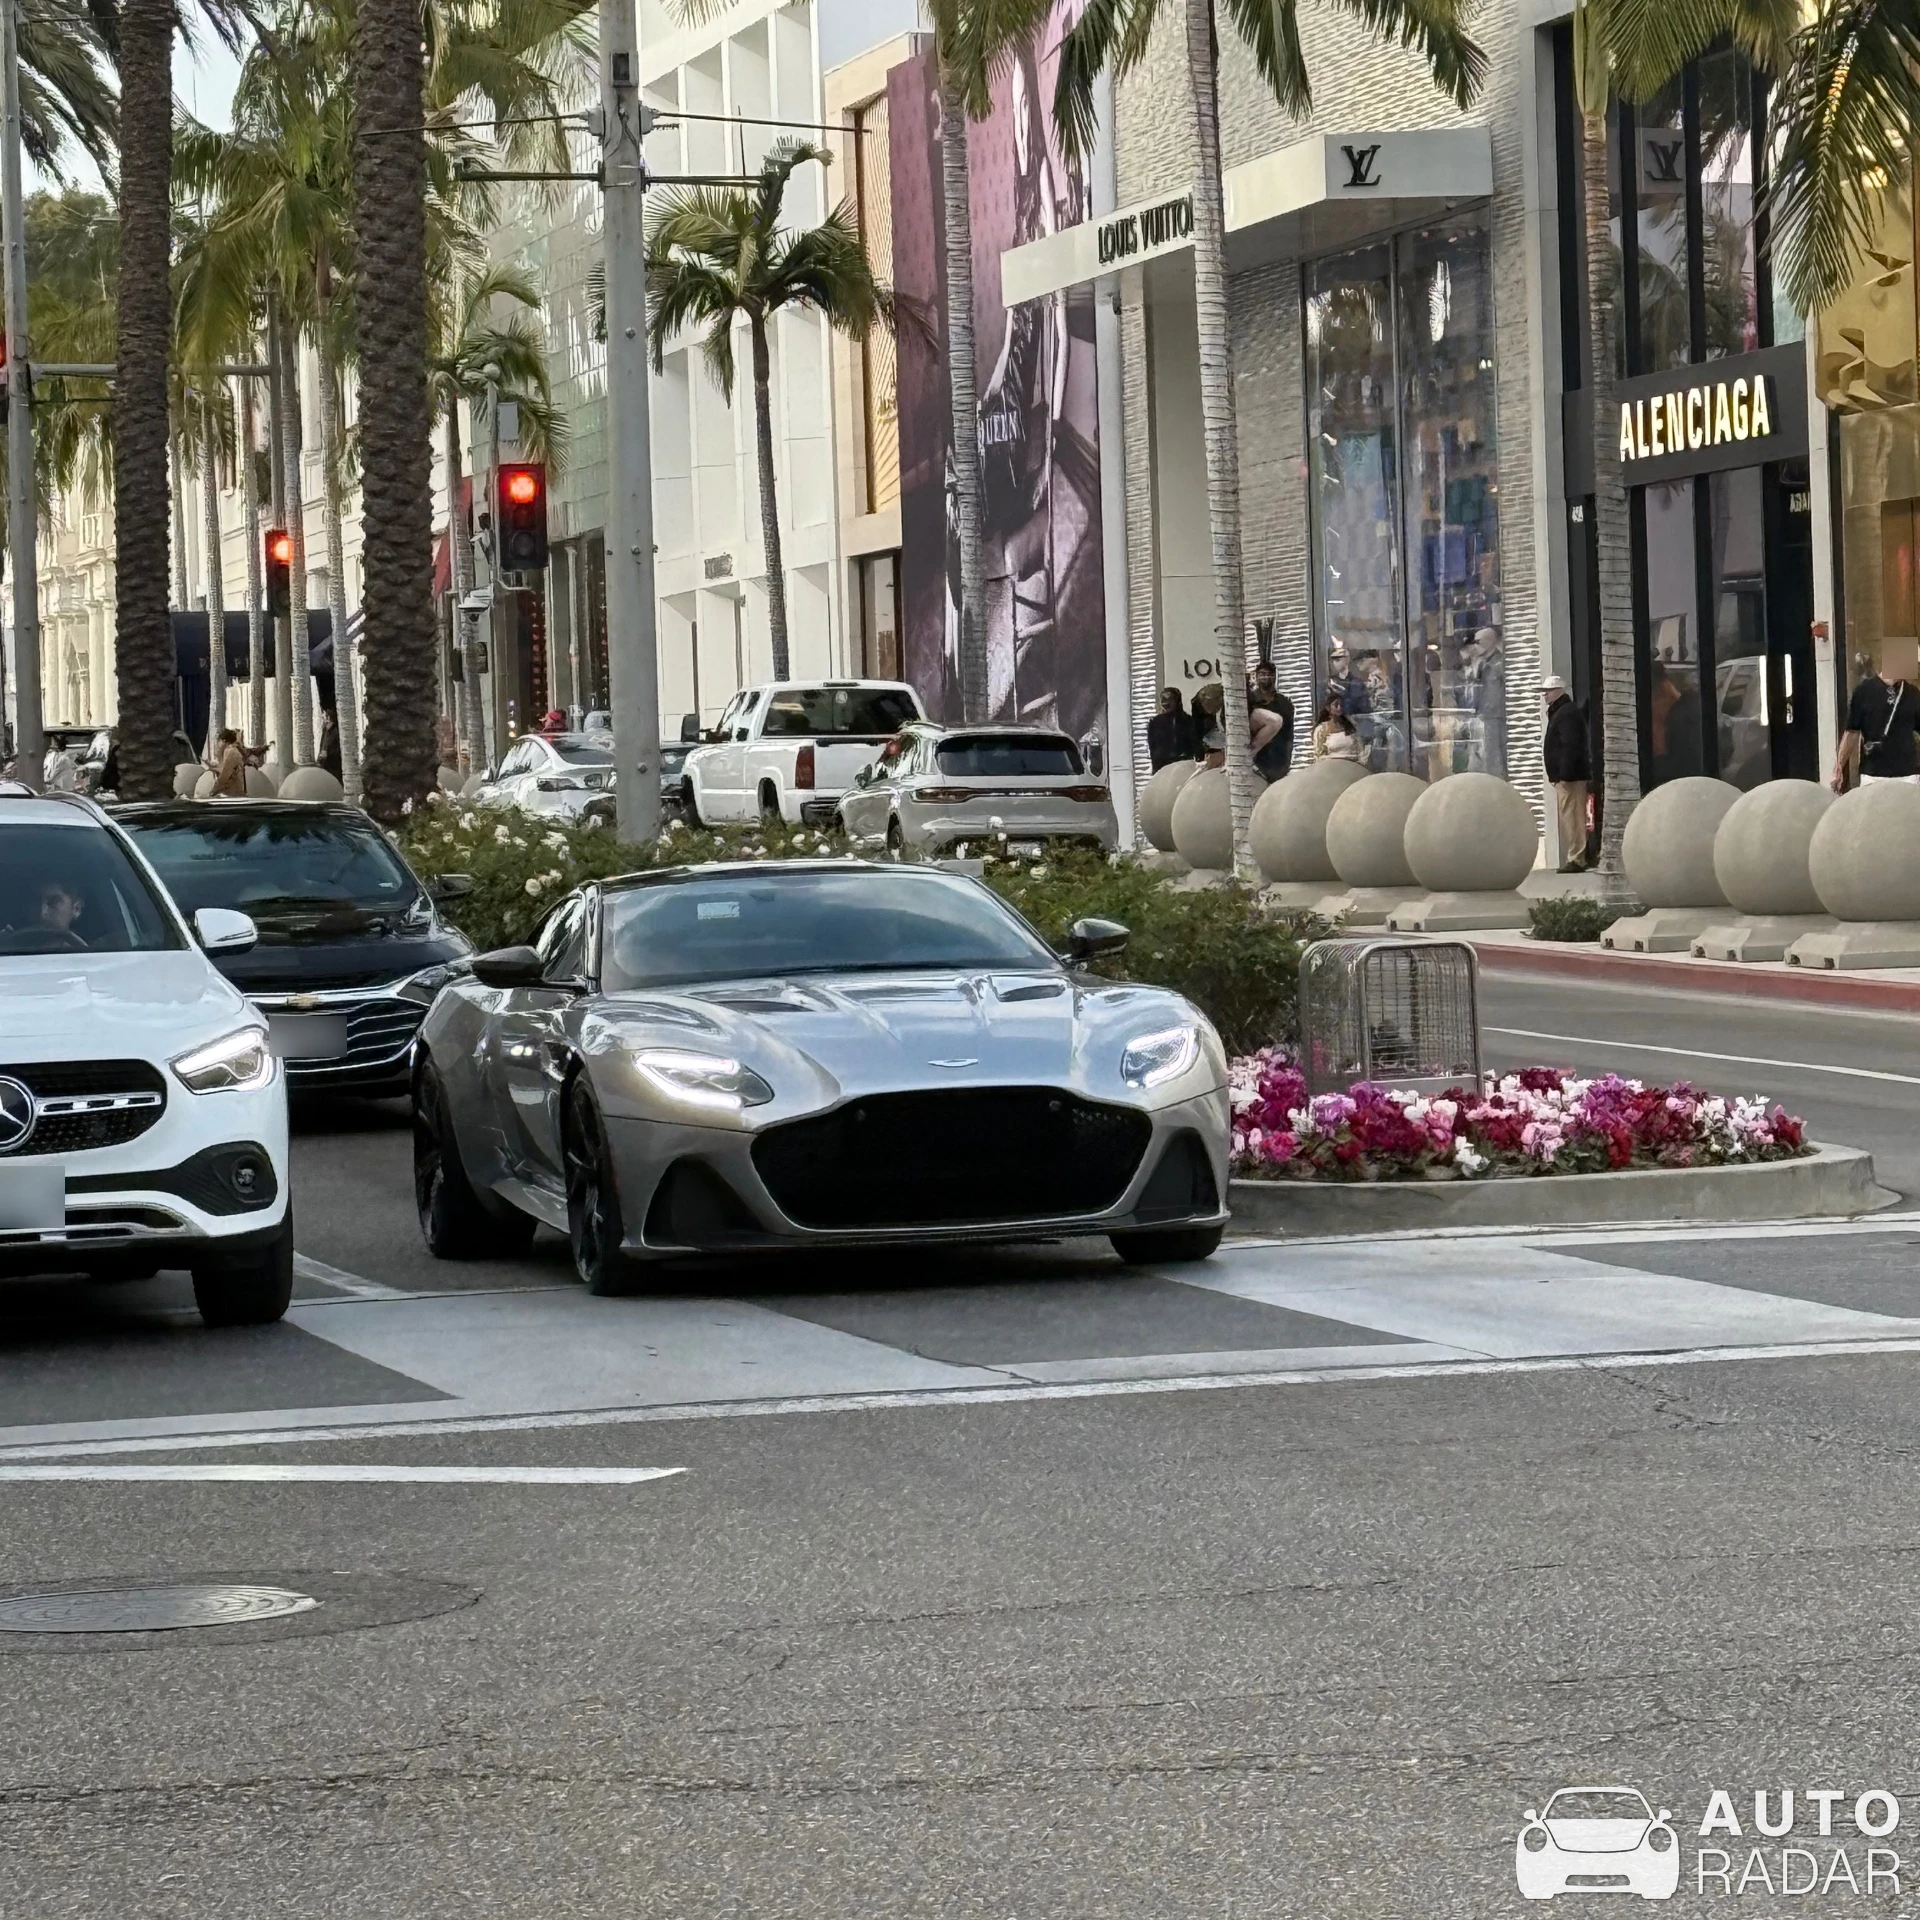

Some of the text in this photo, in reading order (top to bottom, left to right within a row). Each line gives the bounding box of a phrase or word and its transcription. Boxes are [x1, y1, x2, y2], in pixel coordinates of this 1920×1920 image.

[1341, 145, 1382, 187] LV
[1098, 215, 1138, 265] LOUIS
[1620, 374, 1770, 462] ALENCIAGA
